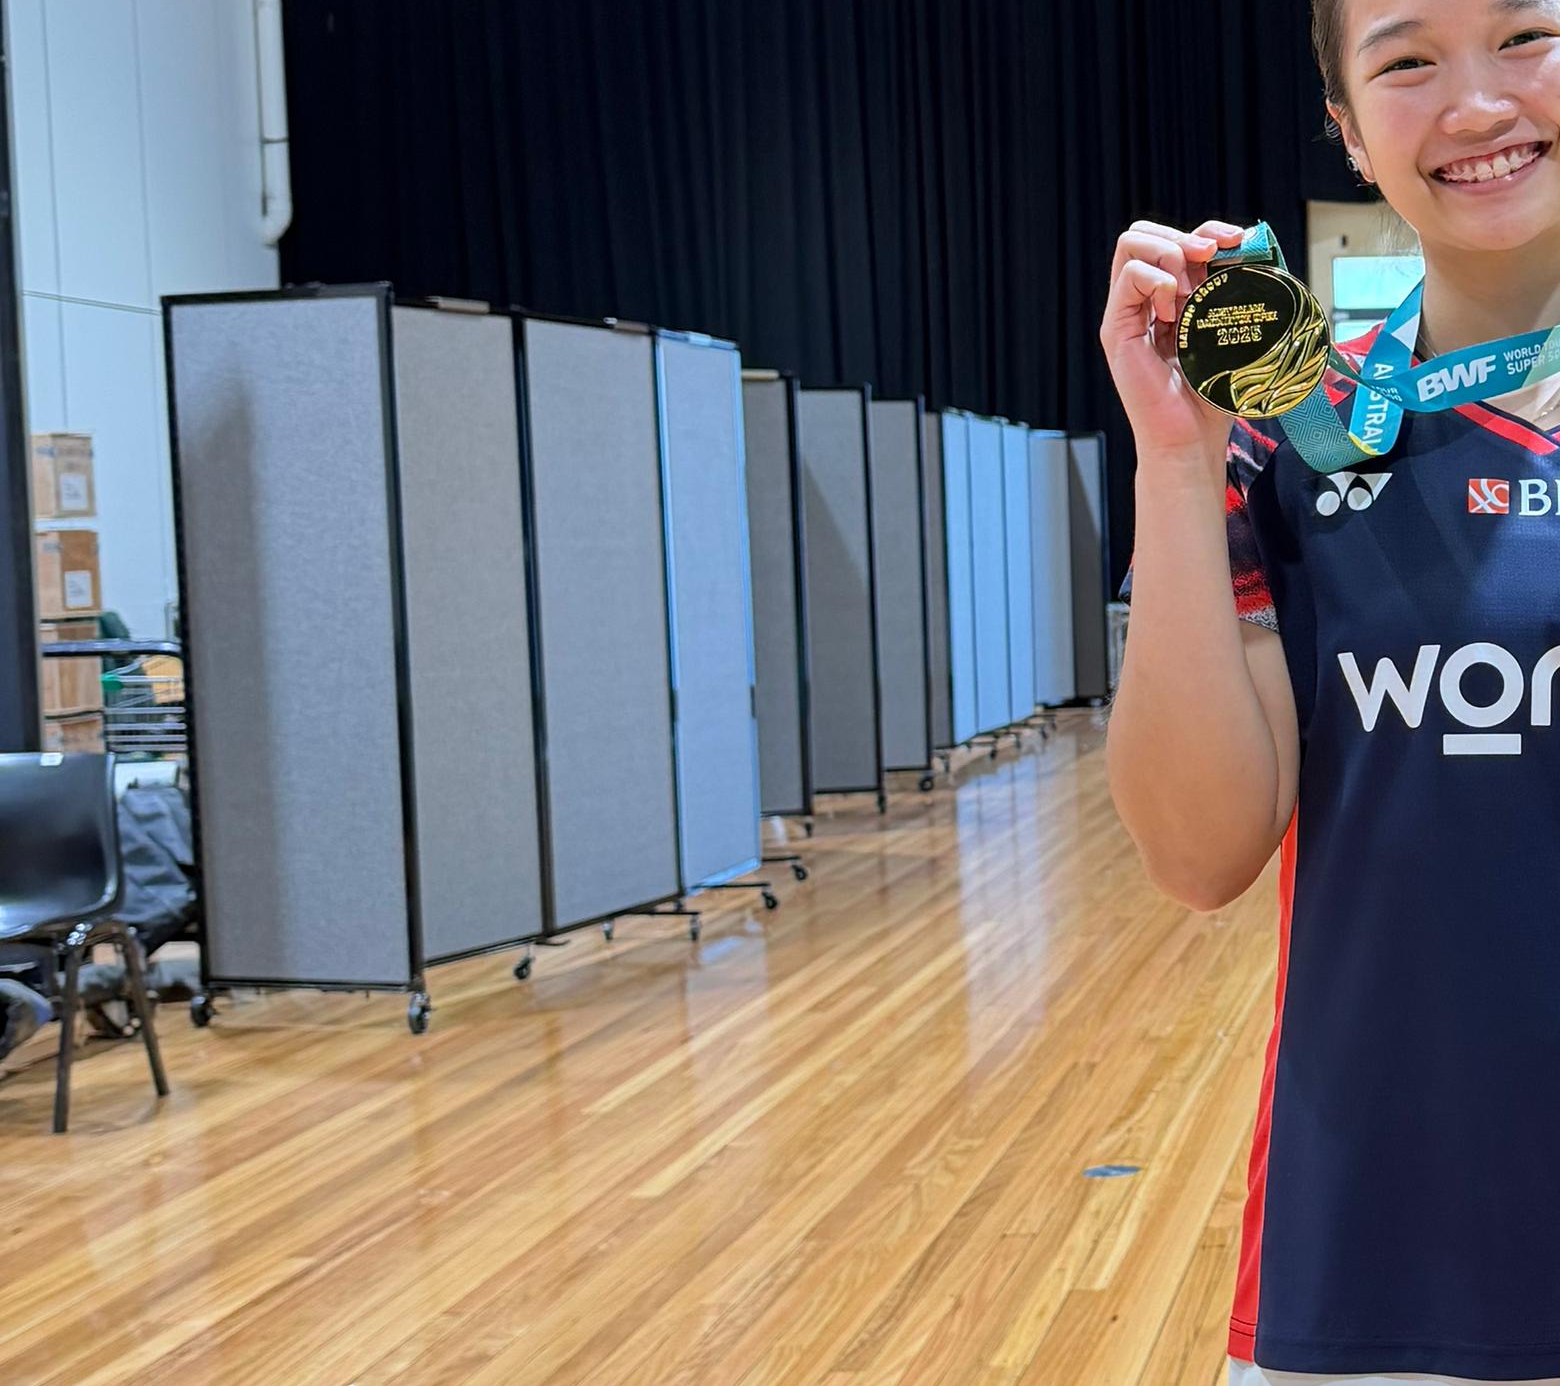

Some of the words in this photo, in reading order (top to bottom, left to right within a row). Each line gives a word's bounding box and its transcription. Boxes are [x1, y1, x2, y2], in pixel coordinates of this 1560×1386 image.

[1217, 325, 1263, 346] 2025
[1503, 343, 1540, 362] WORLD
[1506, 355, 1546, 376] SUPER
[1416, 354, 1496, 402] BWF
